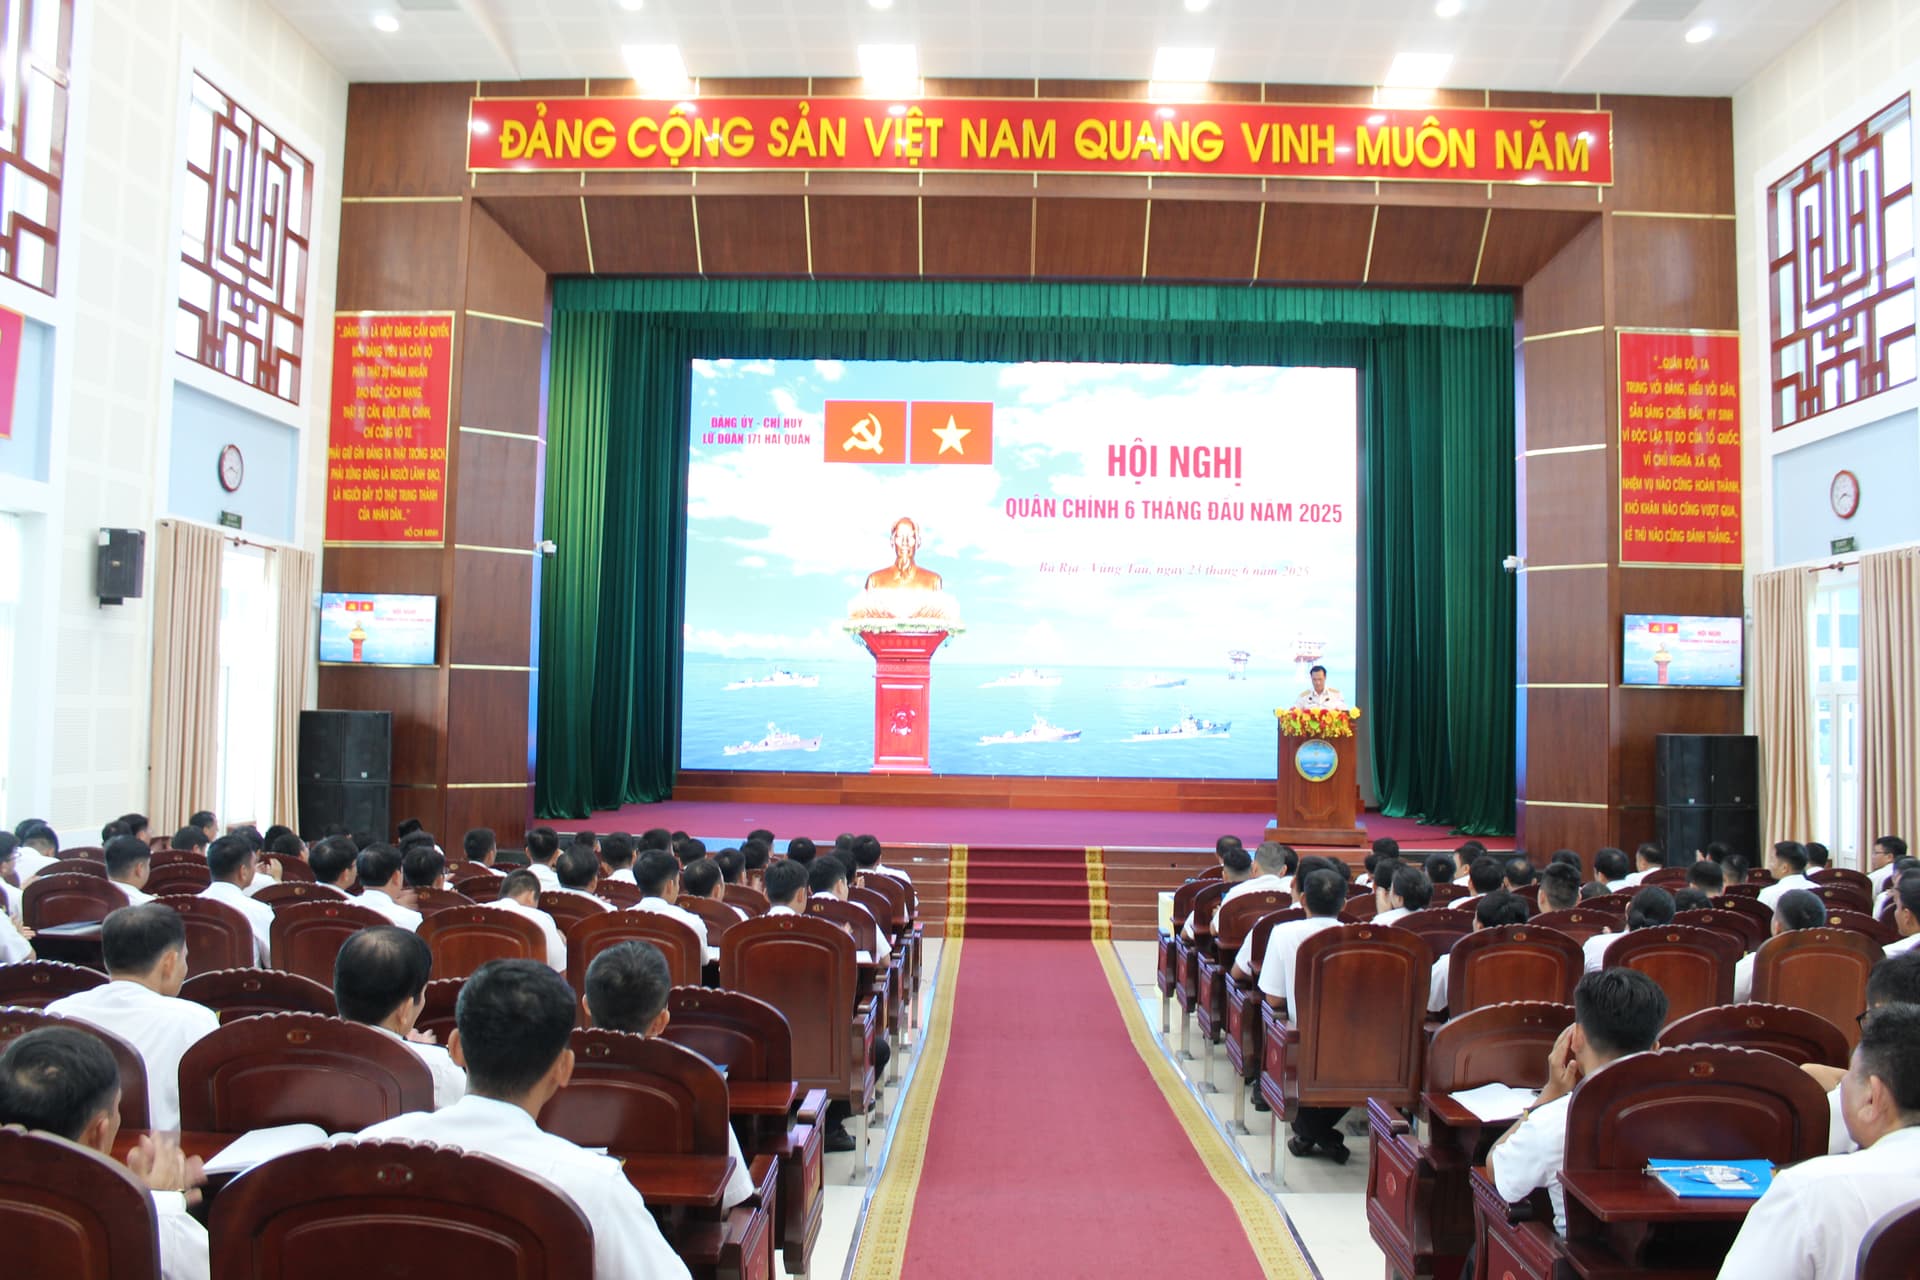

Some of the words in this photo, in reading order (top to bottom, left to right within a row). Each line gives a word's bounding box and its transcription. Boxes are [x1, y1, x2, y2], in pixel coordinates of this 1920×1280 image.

[499, 102, 616, 159] ĐẢNG
[627, 105, 754, 166] CỘNG
[768, 101, 846, 158] SẢN
[864, 106, 943, 165] VIỆT
[961, 118, 1056, 159] NAM
[1074, 119, 1224, 162] QUANG
[1241, 123, 1335, 164] VINH
[1356, 115, 1475, 168] MUÔN
[1495, 120, 1589, 172] NĂM
[784, 418, 803, 429] HUY
[747, 434, 761, 445] 171
[1108, 438, 1157, 484] HỘI
[1170, 446, 1242, 486] NGHỊ
[1006, 494, 1056, 519] QUÂN
[1062, 495, 1119, 519] CHÍNH
[1125, 500, 1135, 519] 6
[1141, 496, 1201, 521] THÁNG
[1207, 494, 1244, 521] ĐẦU
[1250, 498, 1292, 522] NĂM
[1299, 503, 1342, 523] 2025
